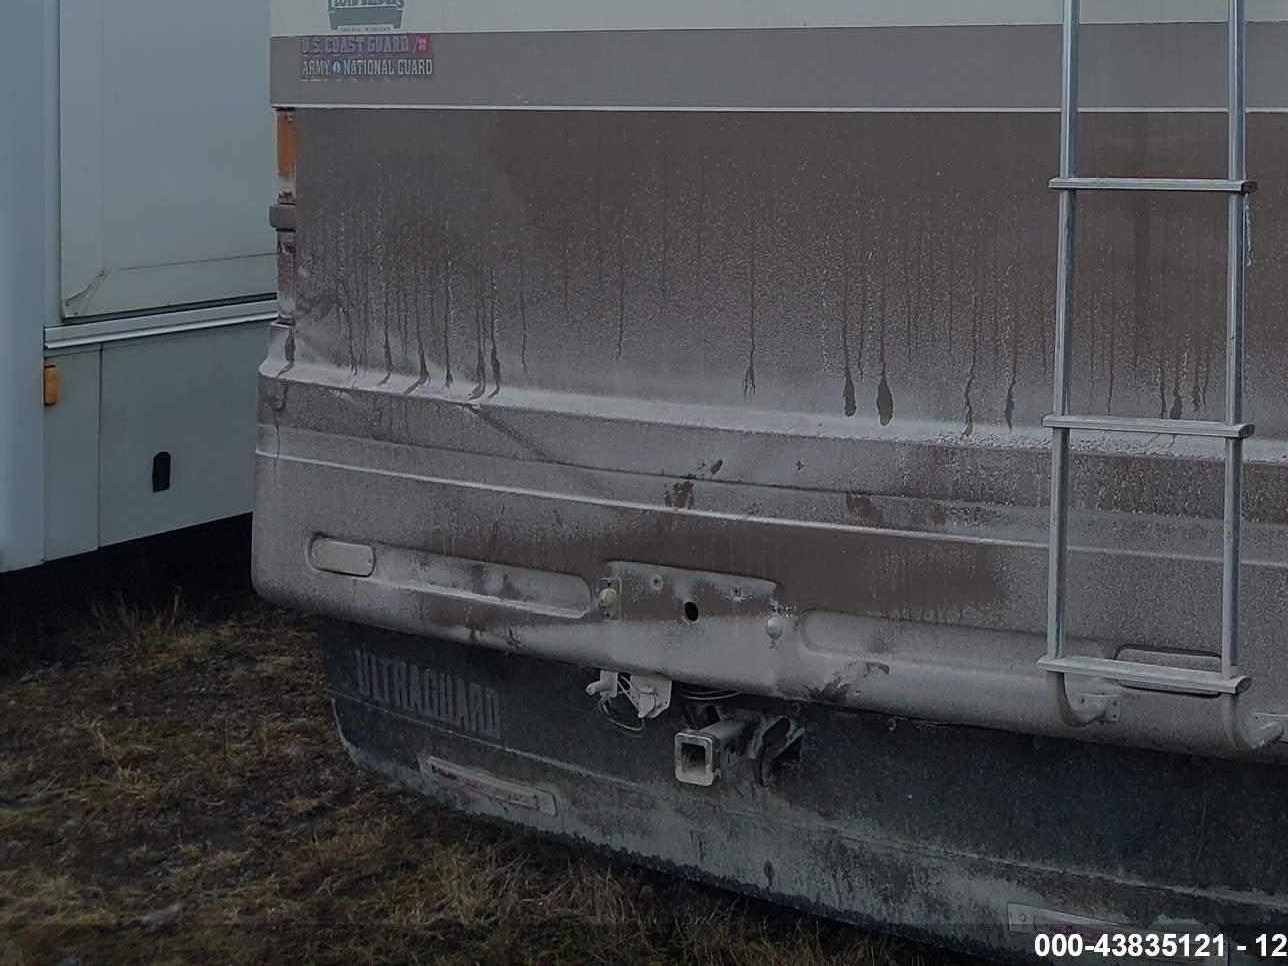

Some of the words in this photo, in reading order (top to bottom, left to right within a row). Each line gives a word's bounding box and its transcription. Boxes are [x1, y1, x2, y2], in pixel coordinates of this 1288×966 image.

[302, 37, 323, 53] U.S.
[326, 36, 365, 53] COAST
[367, 35, 409, 53] GUARD
[303, 59, 330, 75] ARMY
[343, 58, 394, 75] NATIONAL
[397, 58, 433, 75] GUARD
